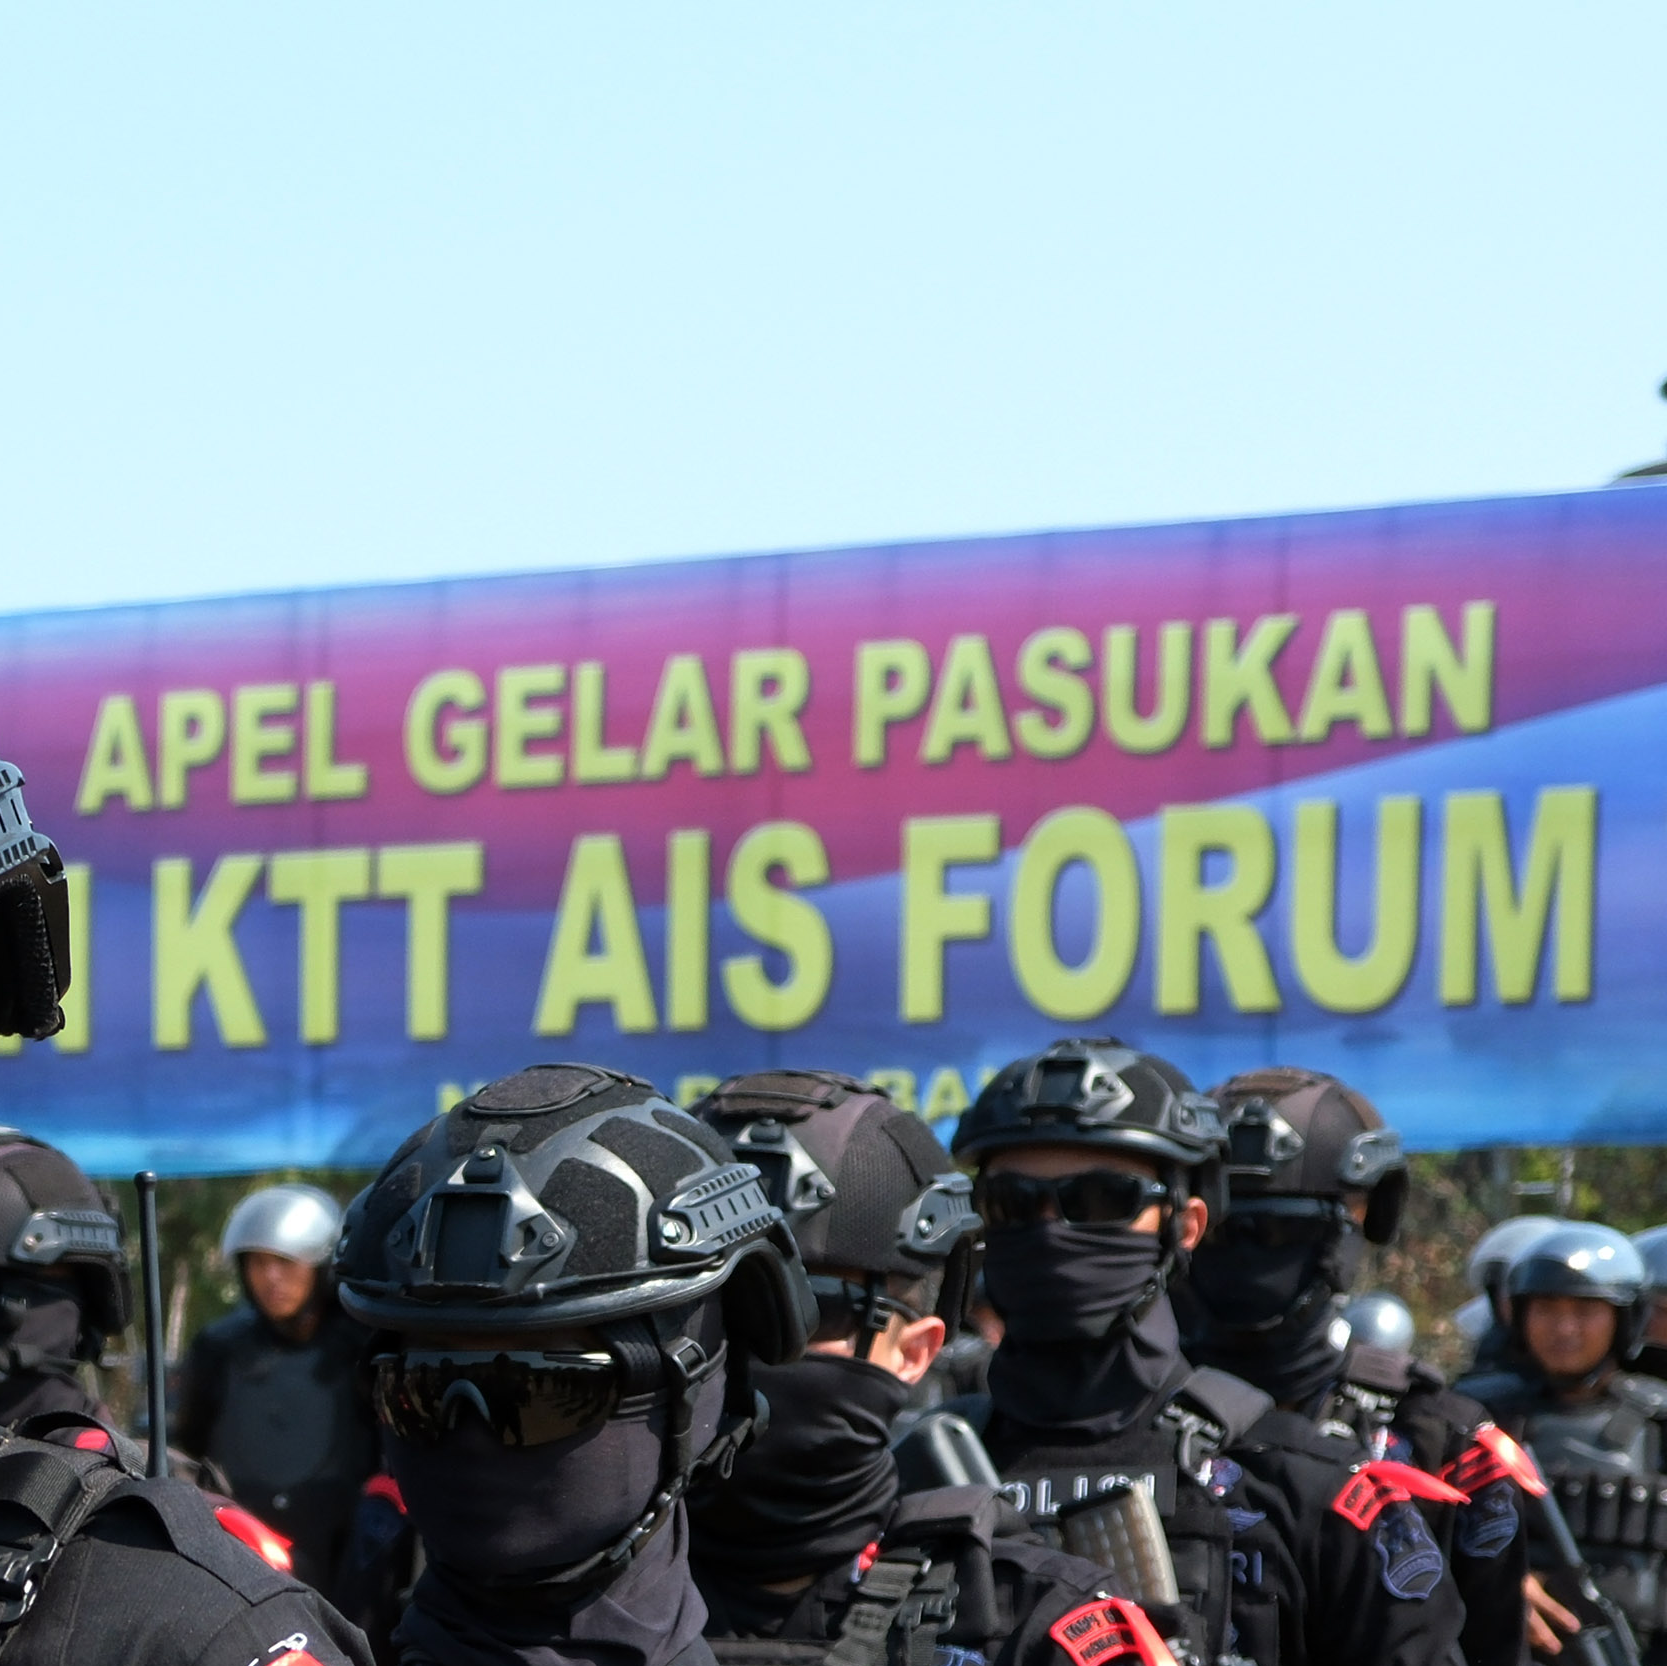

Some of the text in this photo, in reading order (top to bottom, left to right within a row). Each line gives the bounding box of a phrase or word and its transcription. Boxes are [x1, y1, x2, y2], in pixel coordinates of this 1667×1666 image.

[77, 600, 1496, 815] APEL GELAR PASUKAN
[151, 841, 484, 1051] KTT
[533, 820, 834, 1037] AIS
[899, 785, 1599, 1024] FORUM
[874, 1067, 999, 1122] BA
[1001, 1471, 1156, 1516] OLISI
[1230, 1551, 1262, 1585] RI
